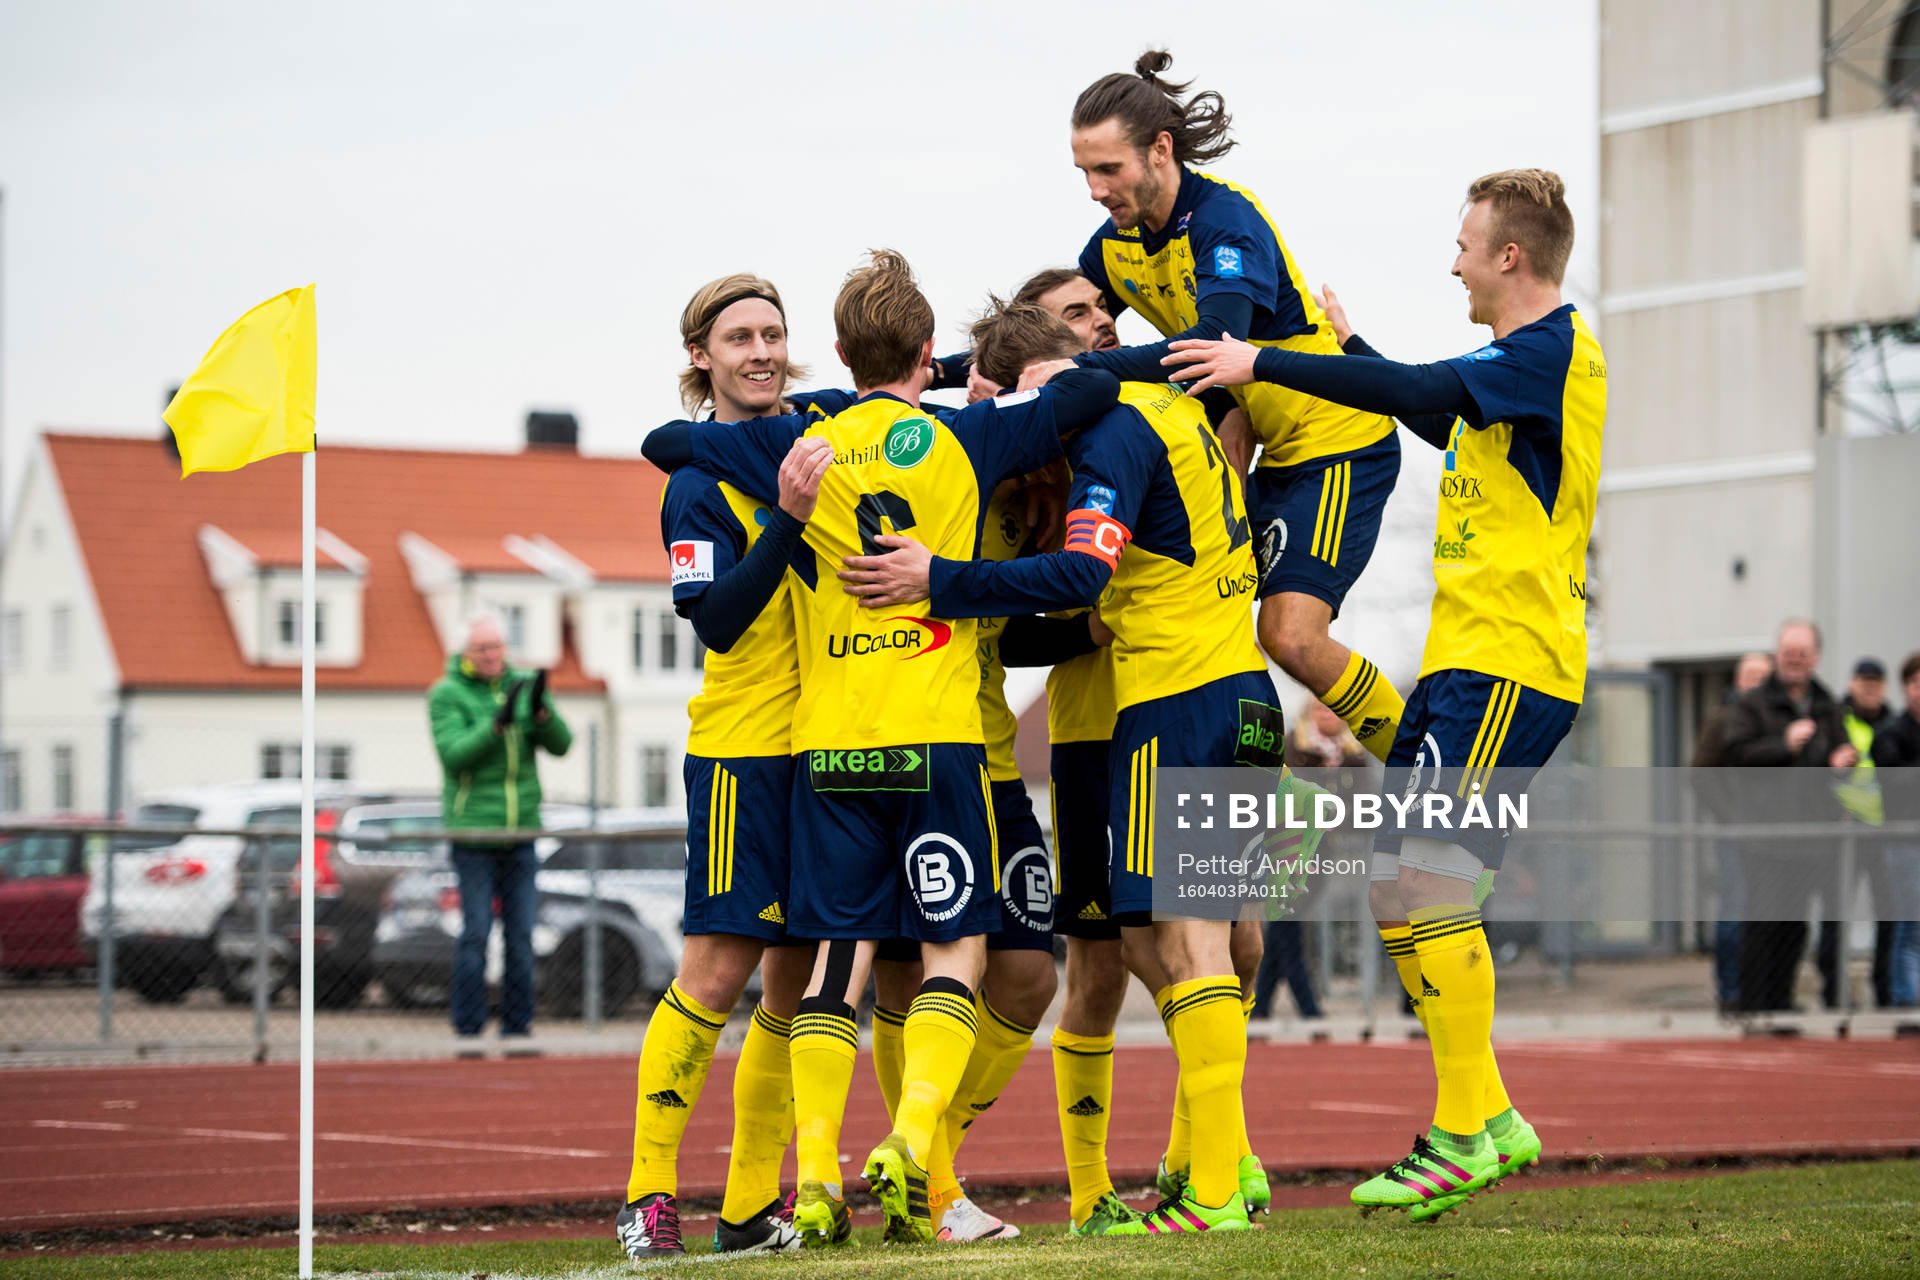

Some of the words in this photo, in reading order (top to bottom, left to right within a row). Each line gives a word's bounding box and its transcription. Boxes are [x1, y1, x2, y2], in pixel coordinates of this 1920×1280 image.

[831, 444, 879, 465] kahill
[1095, 522, 1122, 556] C
[1434, 534, 1467, 559] less
[812, 750, 885, 773] akea
[646, 1094, 689, 1109] adidas
[1067, 1106, 1104, 1116] adidas
